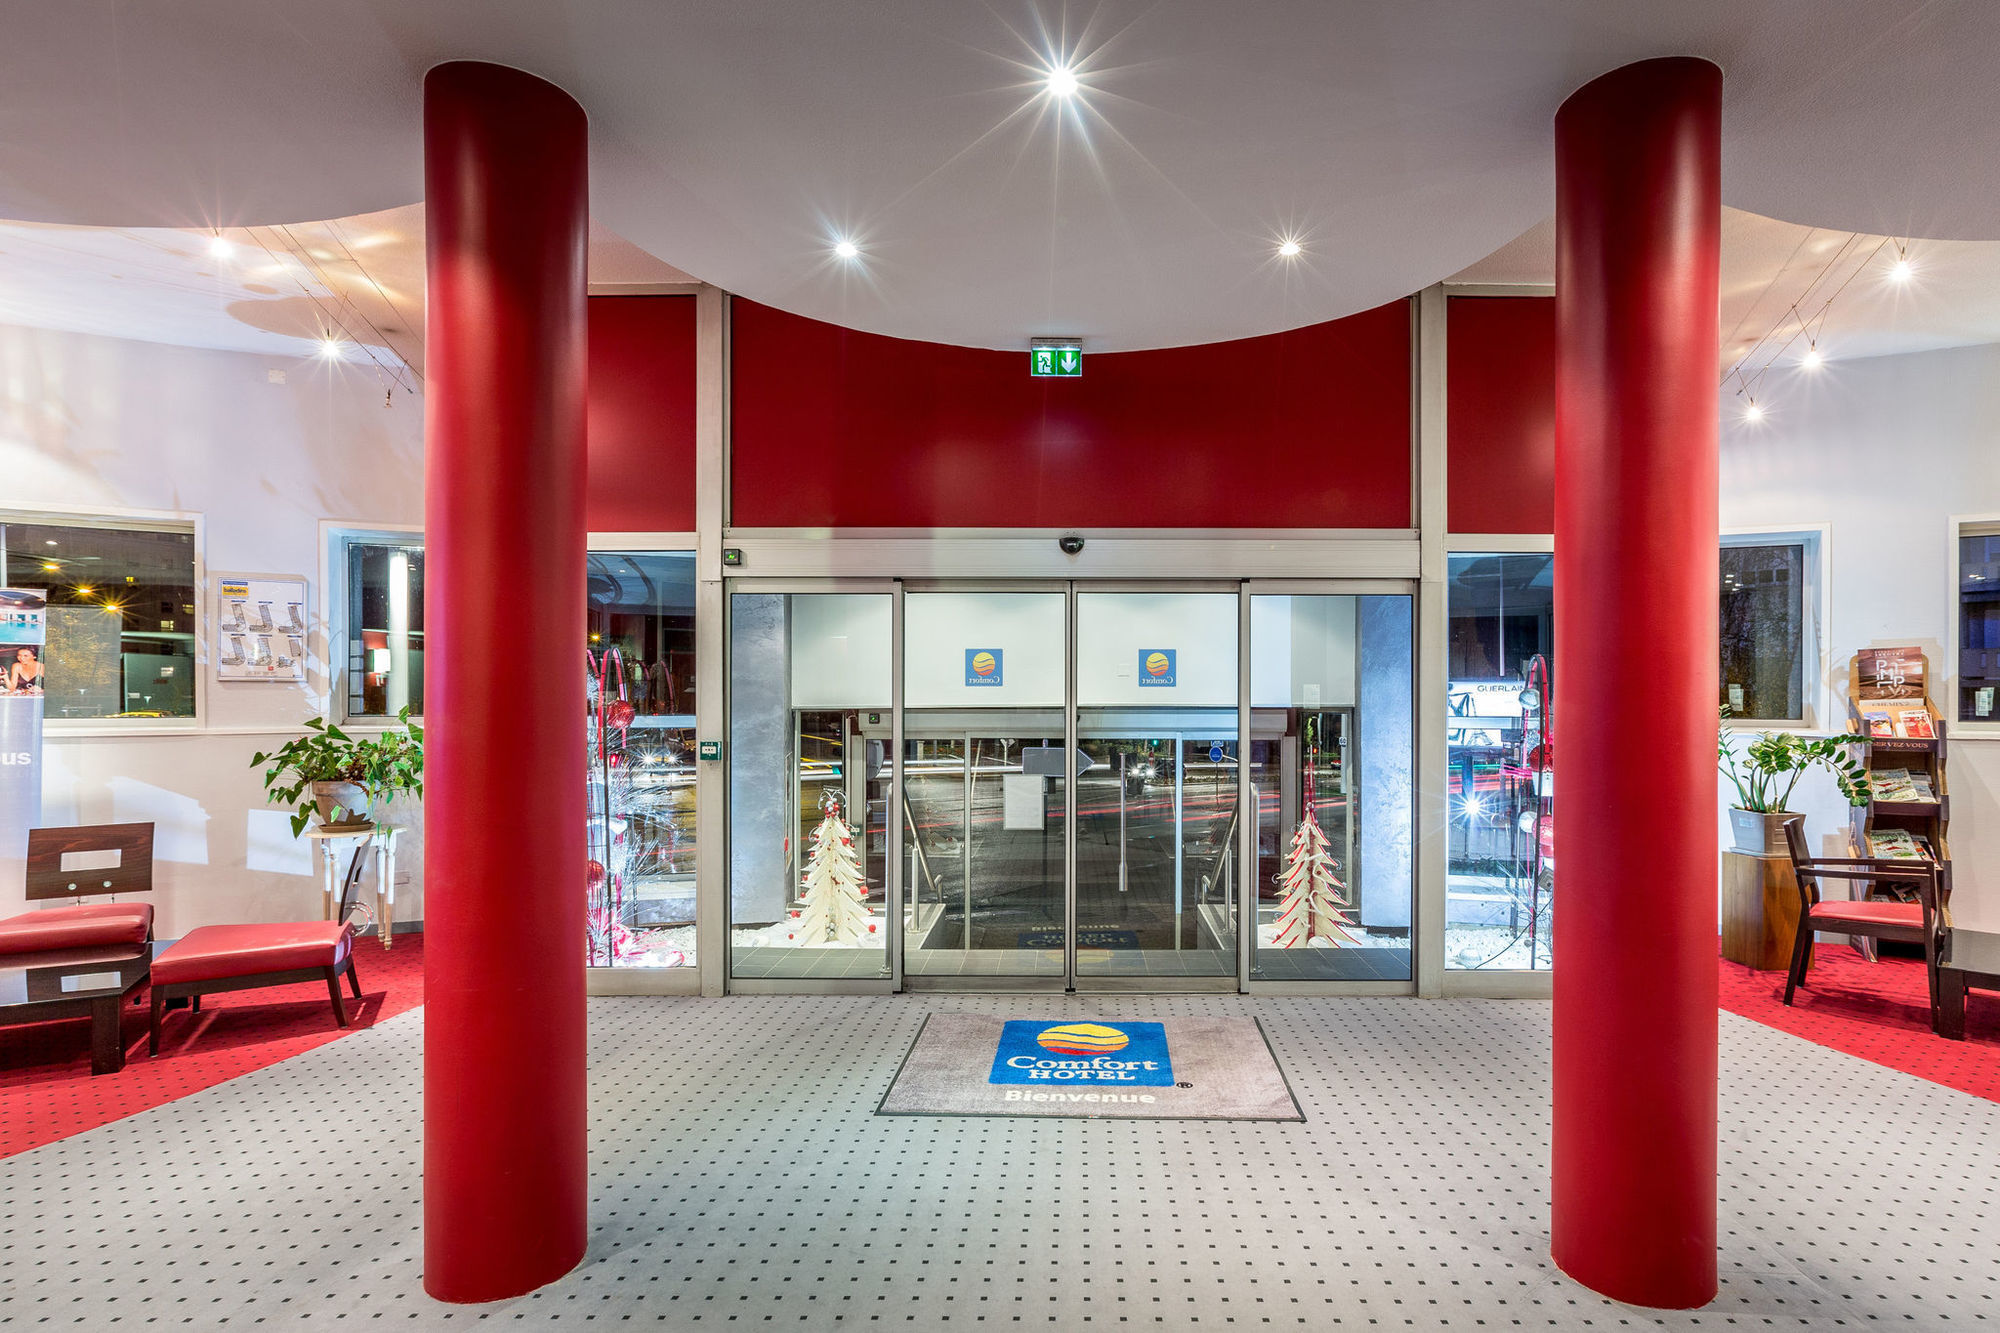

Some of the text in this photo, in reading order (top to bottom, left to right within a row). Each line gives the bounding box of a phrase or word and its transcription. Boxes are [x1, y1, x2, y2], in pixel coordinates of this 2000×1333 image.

[0, 752, 32, 766] us
[1007, 1055, 1159, 1071] Comfort
[1028, 1069, 1136, 1080] HOTEL
[1005, 1090, 1156, 1104] Bienvenue
